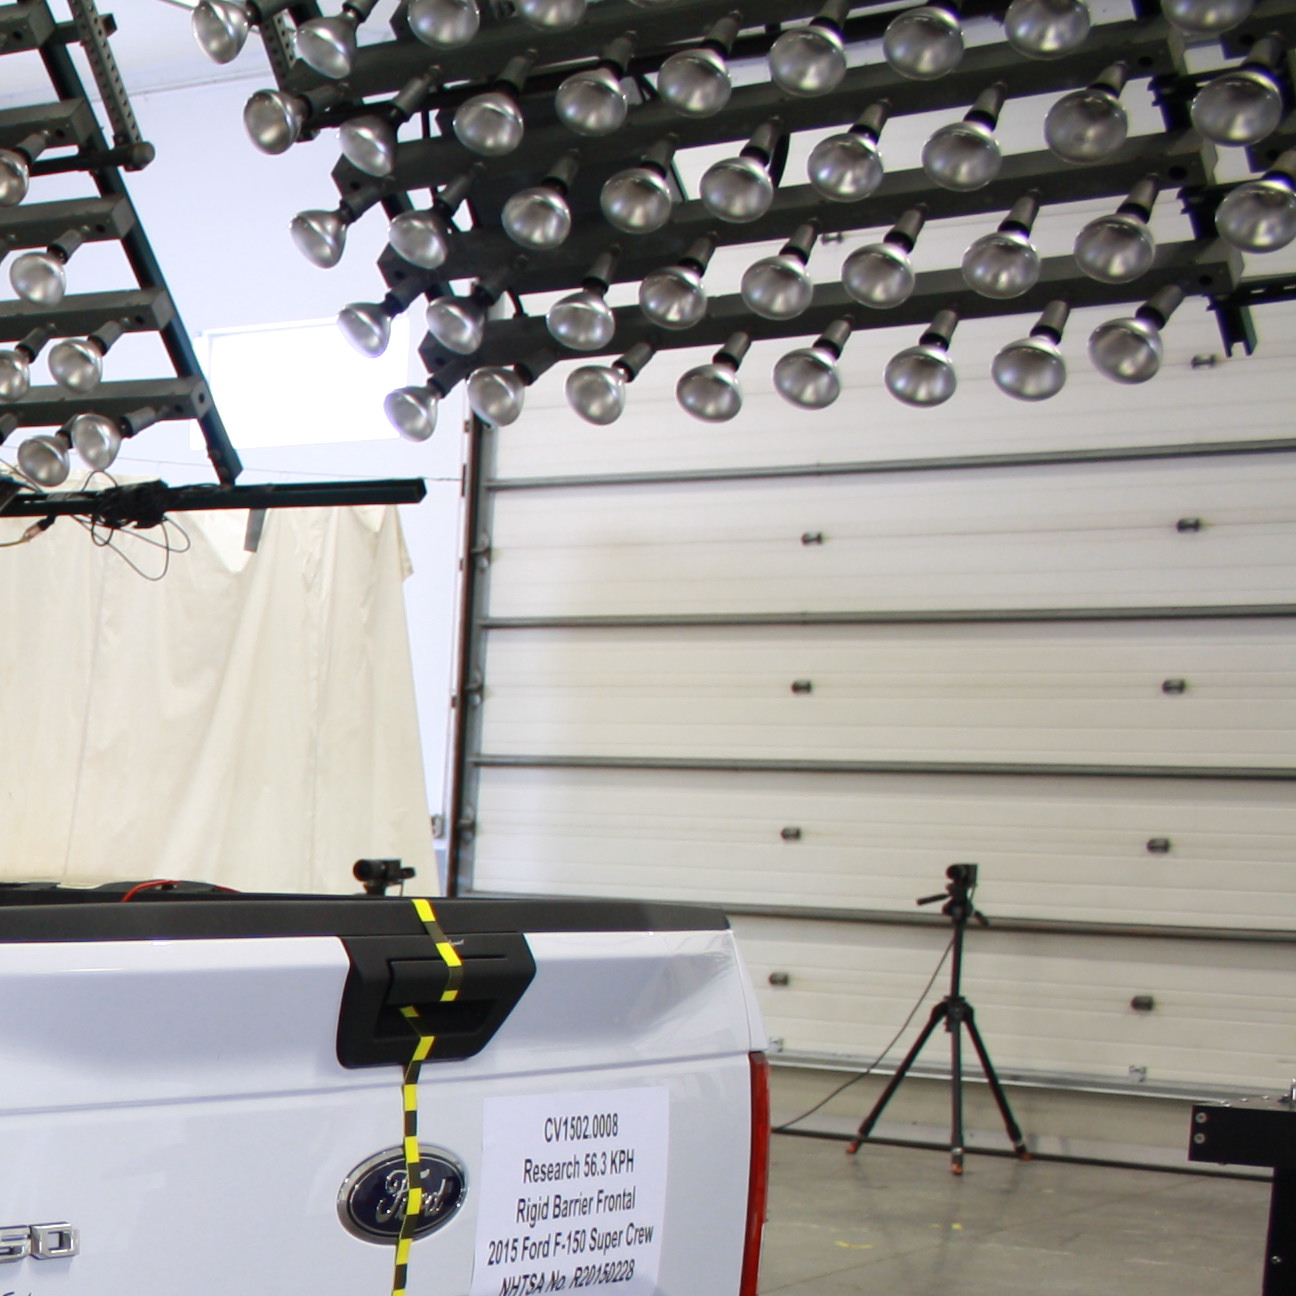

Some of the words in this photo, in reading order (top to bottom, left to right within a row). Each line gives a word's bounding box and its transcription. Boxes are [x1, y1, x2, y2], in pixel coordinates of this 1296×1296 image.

[544, 1113, 619, 1143] CV1502.0008
[523, 1154, 580, 1184] Research
[583, 1152, 607, 1179] 56.3
[610, 1149, 634, 1175] KPH
[516, 1196, 548, 1229] Rigid
[553, 1191, 593, 1219] Barrier
[596, 1186, 636, 1215] Frontal
[487, 1238, 518, 1266] 2015
[521, 1233, 550, 1262] Ford
[553, 1229, 586, 1257] F-150
[589, 1226, 623, 1258] Super
[625, 1222, 654, 1246] Crew
[545, 1271, 565, 1294] No.
[569, 1259, 635, 1288] R20150228
